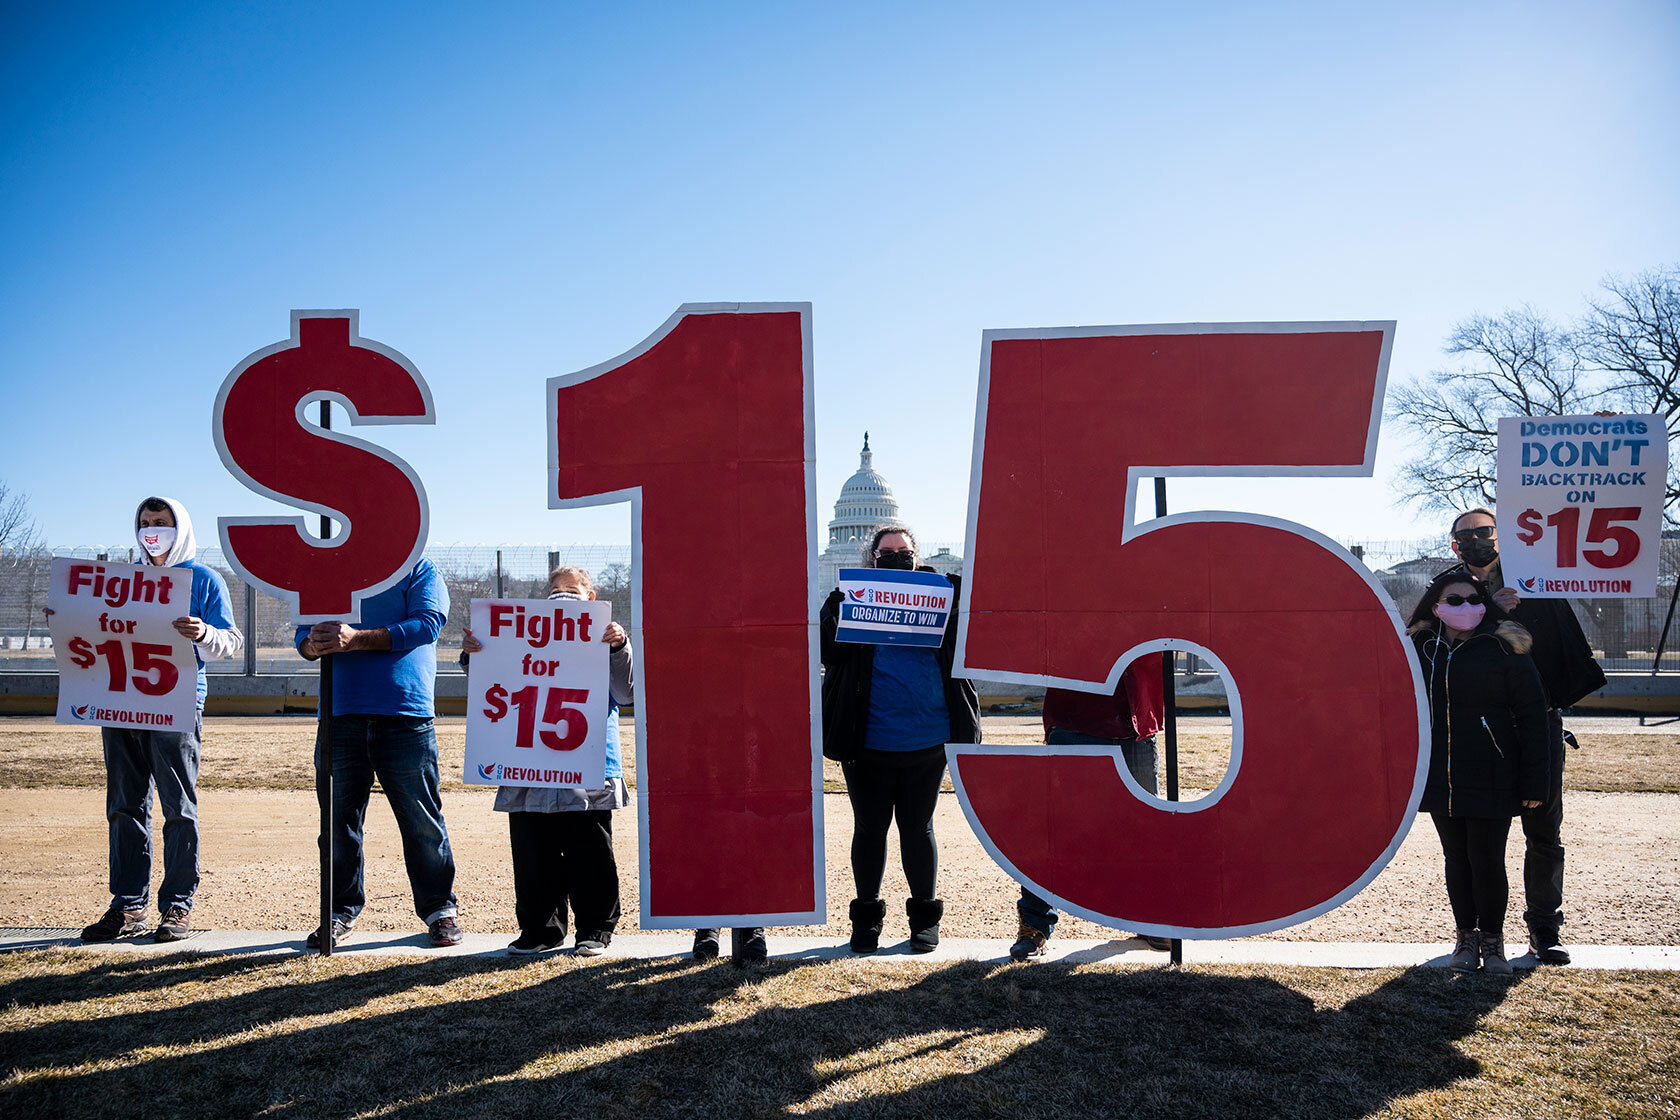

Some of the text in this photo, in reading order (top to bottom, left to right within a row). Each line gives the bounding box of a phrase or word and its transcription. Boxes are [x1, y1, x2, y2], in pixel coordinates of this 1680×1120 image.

[1520, 420, 1648, 437] Democrats
[1521, 439, 1649, 468] DON'T
[1521, 472, 1647, 486] BACKTRACK
[1566, 490, 1595, 503] ON
[1516, 507, 1642, 569] $15
[67, 565, 173, 608] Fight
[1545, 580, 1632, 593] REVOLUTION
[875, 591, 946, 609] REVOLUTION
[98, 612, 137, 635] for
[490, 605, 592, 648] Fight
[851, 606, 938, 626] ORGANIZE TO WIN
[68, 636, 179, 696] $15
[522, 653, 560, 676] for
[96, 708, 173, 726] REVOLUTION
[483, 683, 590, 751] $15
[503, 767, 582, 784] REVOLUTION
